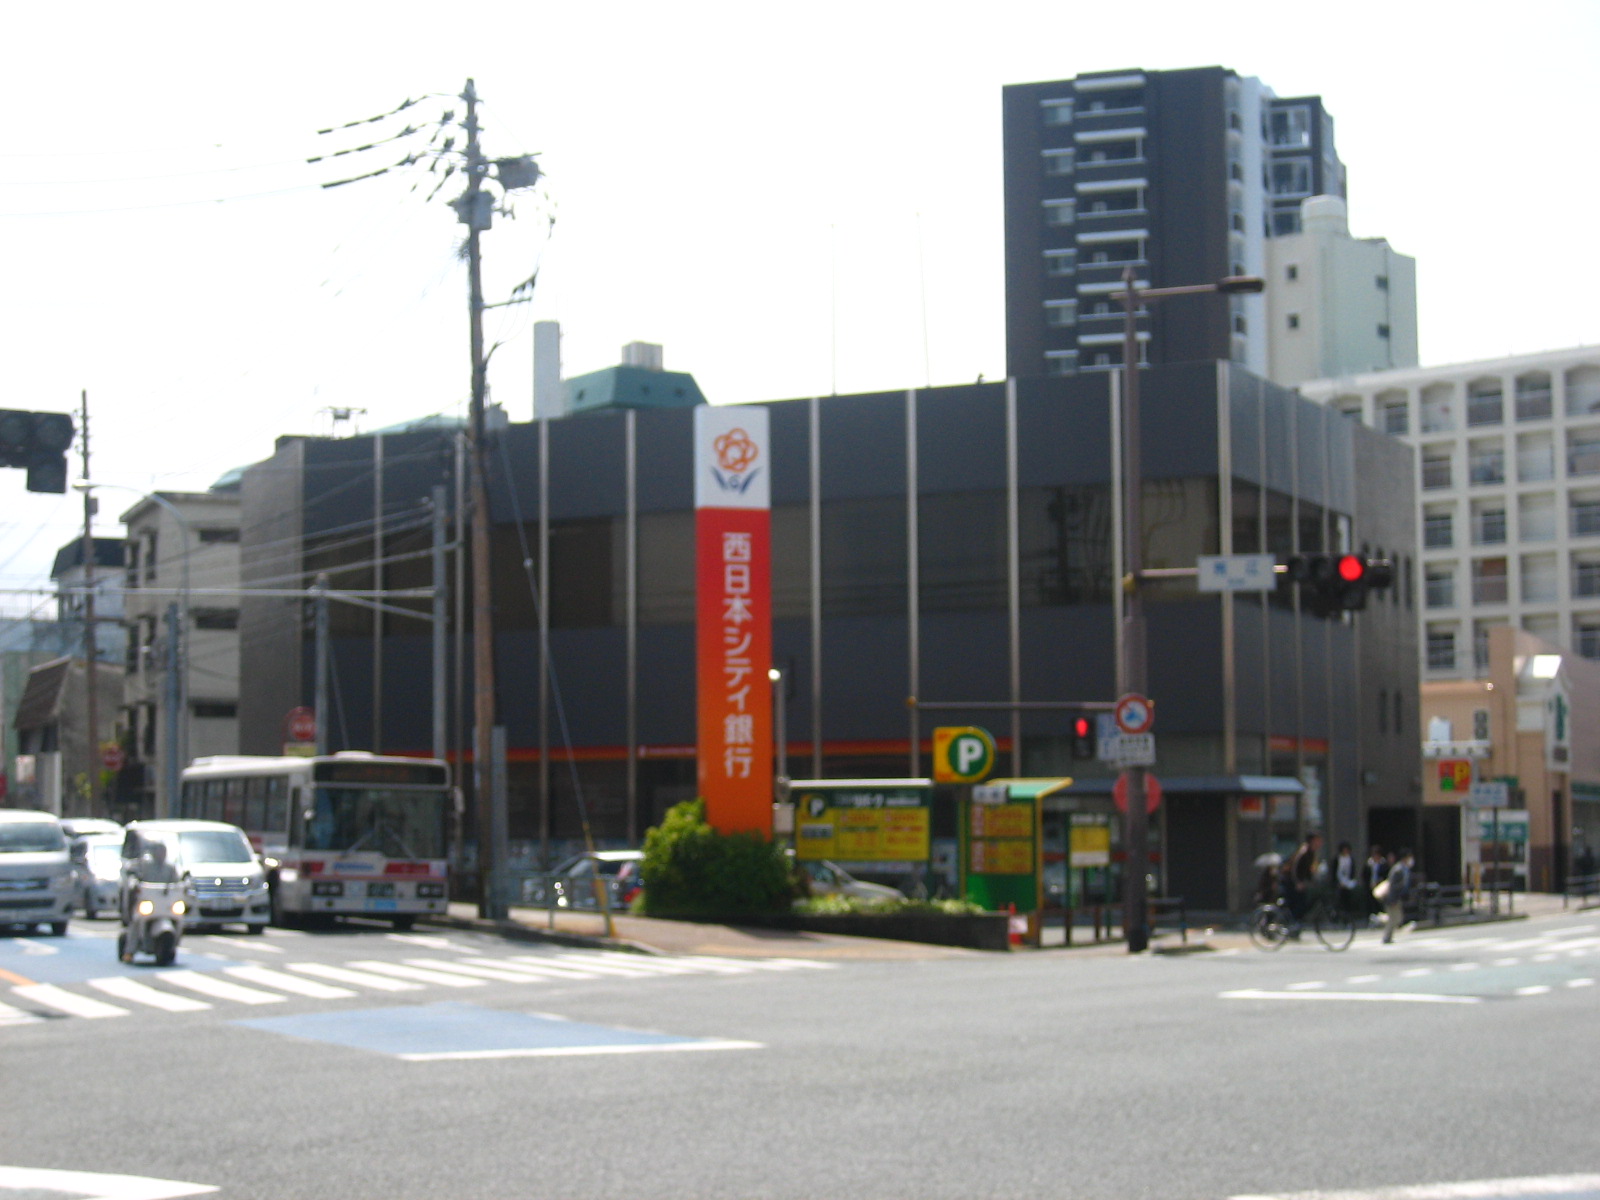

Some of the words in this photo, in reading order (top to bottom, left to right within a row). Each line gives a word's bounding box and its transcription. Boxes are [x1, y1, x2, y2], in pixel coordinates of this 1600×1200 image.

[722, 532, 753, 778] 西日本シティ銀行
[959, 738, 984, 773] P
